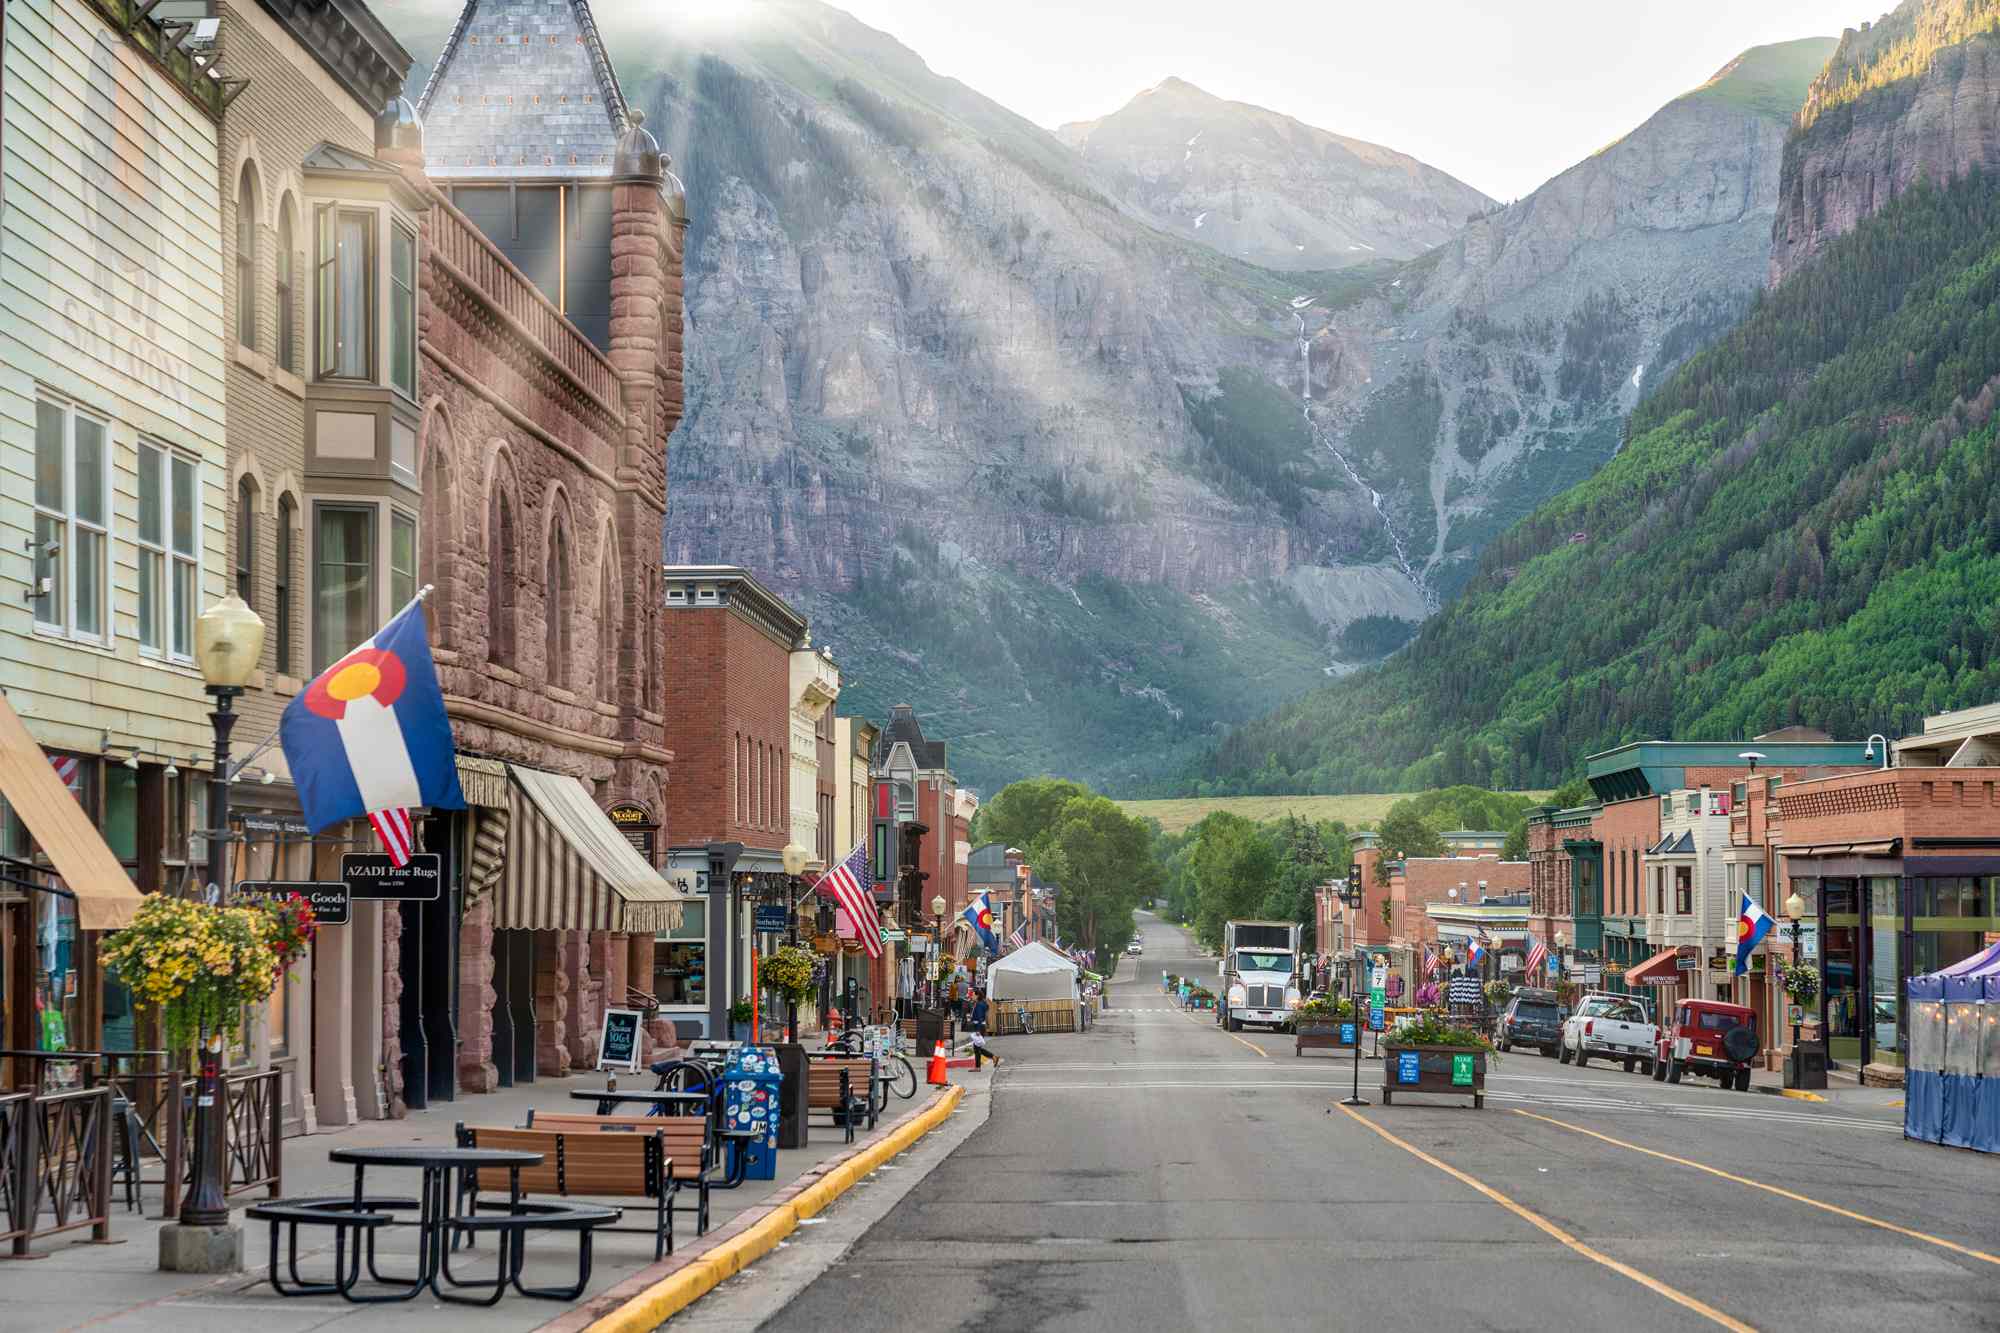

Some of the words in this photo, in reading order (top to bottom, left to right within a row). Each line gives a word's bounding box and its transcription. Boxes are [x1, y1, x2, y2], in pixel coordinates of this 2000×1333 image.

[346, 866, 385, 876] AZADI
[389, 866, 411, 876] Fine
[413, 866, 438, 878] Rugs
[311, 892, 346, 904] Goods
